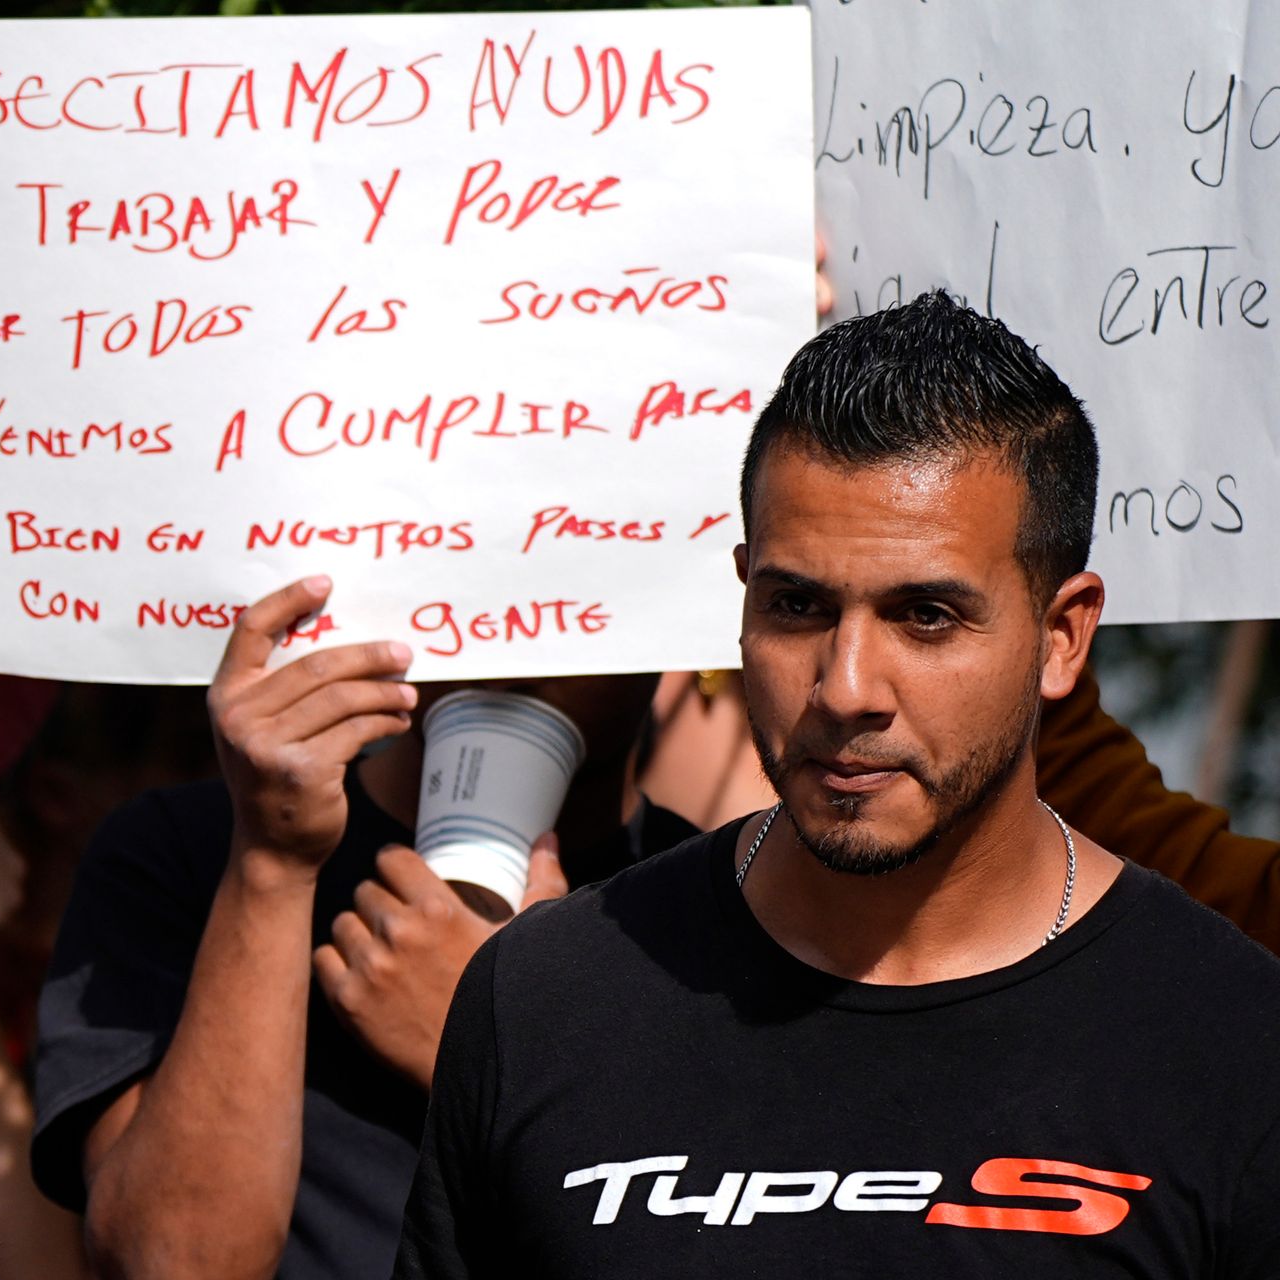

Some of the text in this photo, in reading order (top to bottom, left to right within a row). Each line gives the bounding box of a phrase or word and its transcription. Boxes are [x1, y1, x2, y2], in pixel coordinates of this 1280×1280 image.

[469, 30, 715, 136] AYUDAS
[16, 178, 316, 261] TRABAJAR
[362, 168, 401, 244] Y
[216, 409, 247, 473] A
[278, 391, 609, 462] CUMPLIR
[6, 510, 121, 554] BIEN
[146, 523, 205, 554] EN
[19, 579, 101, 622] CON
